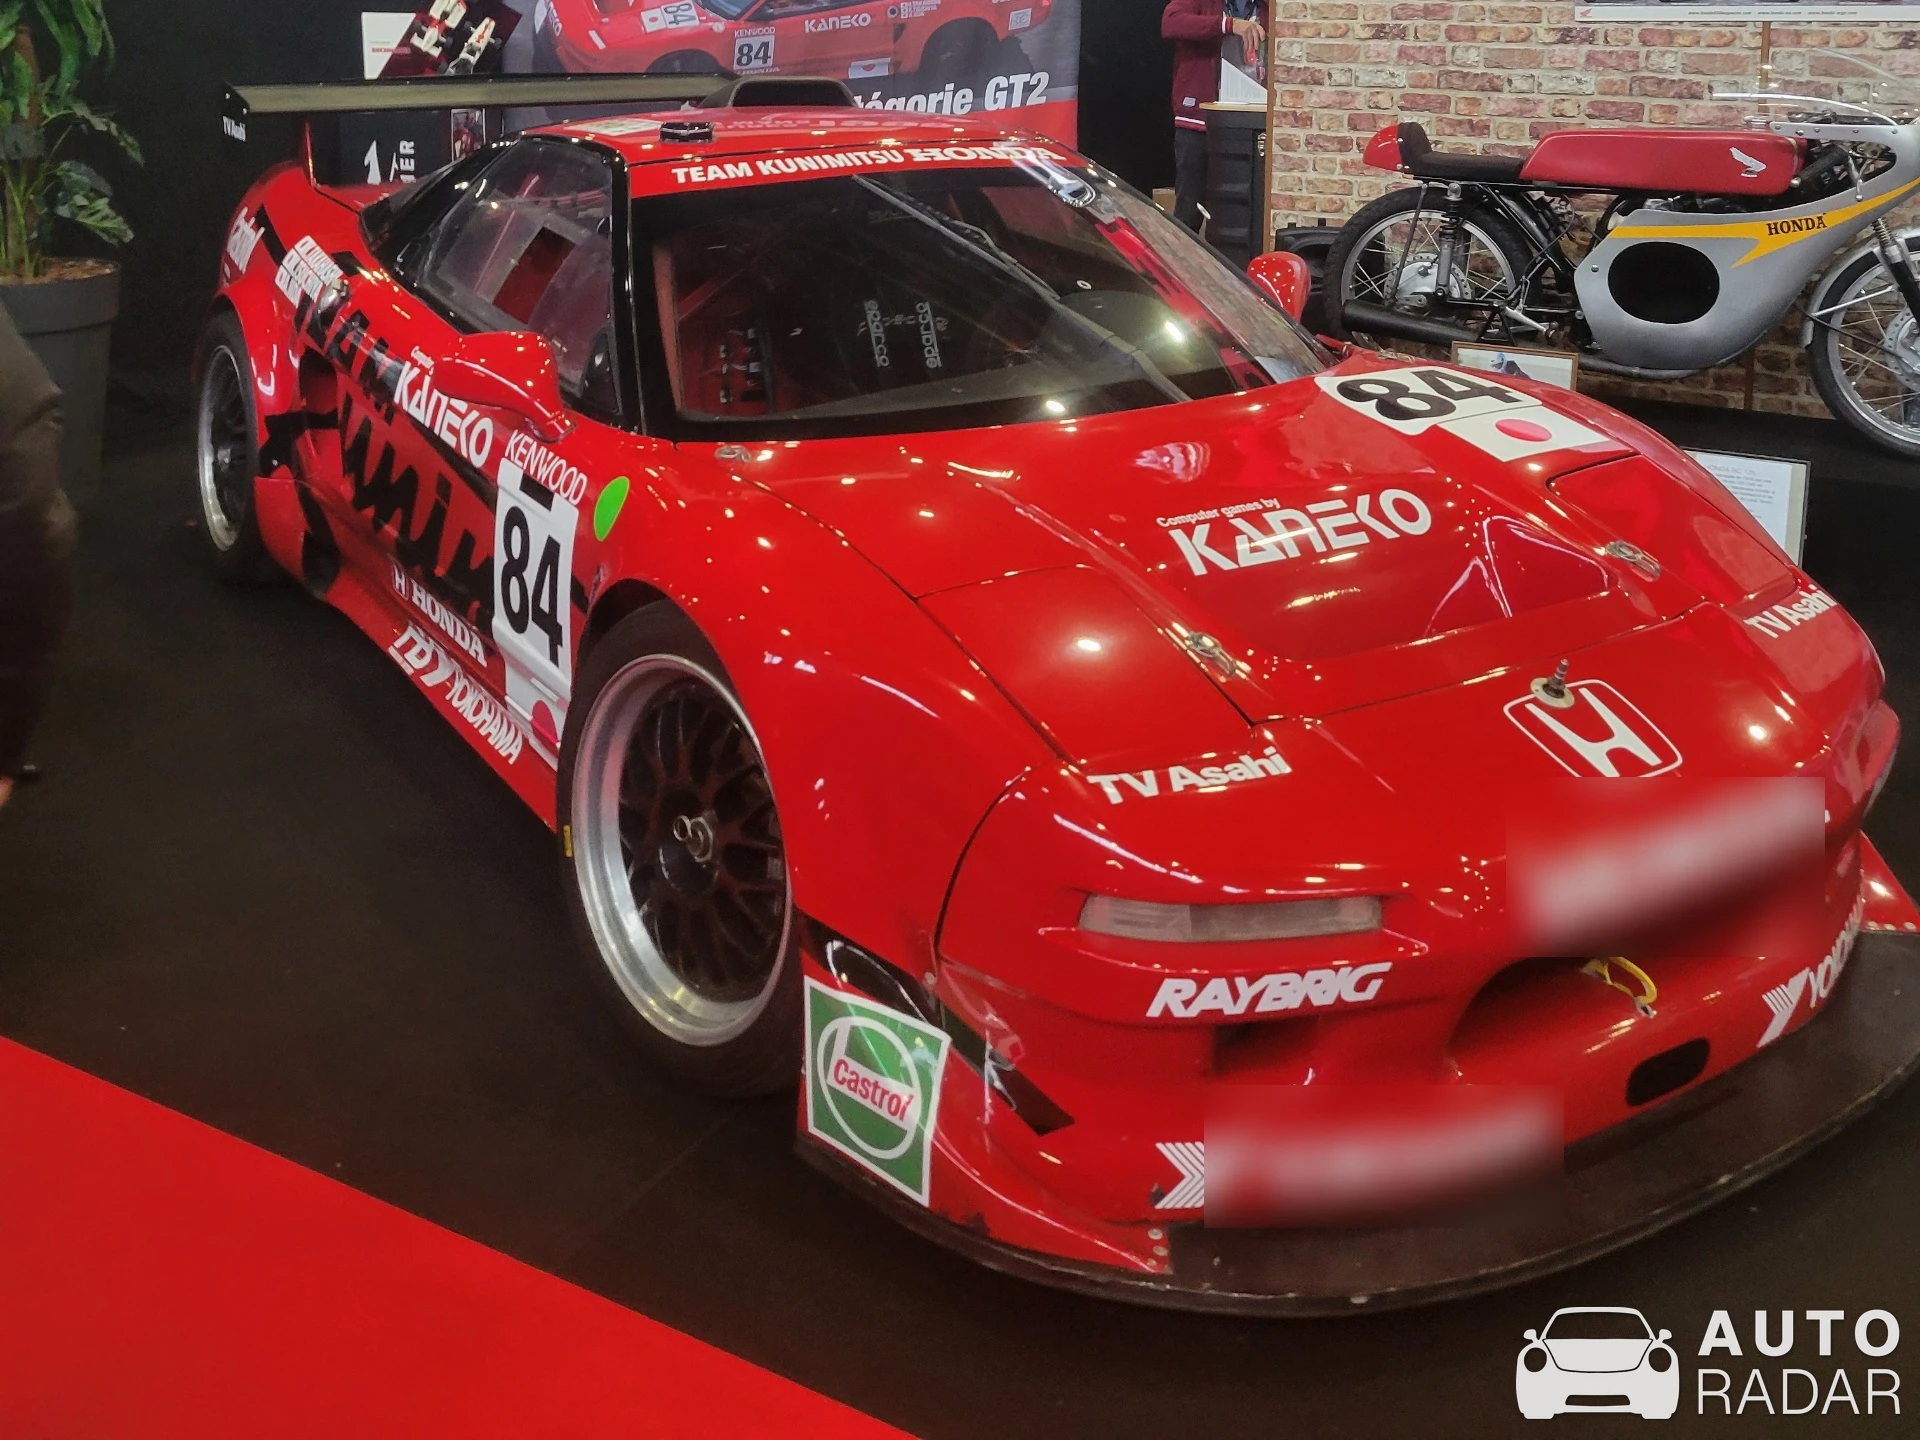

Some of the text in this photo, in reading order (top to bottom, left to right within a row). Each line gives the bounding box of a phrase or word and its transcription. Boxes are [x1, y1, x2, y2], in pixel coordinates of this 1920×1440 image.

[734, 26, 776, 38] KENWOOD
[804, 12, 871, 34] KANEKO
[736, 40, 771, 67] 84
[984, 71, 1049, 111] GT2
[672, 146, 1067, 184] TEAM KUNIMITSU HONDA
[1766, 212, 1828, 236] HONDA
[915, 300, 942, 369] sparco
[394, 361, 494, 468] KANEKO
[1336, 369, 1526, 421] 84
[505, 428, 588, 506] KENWOOD
[1156, 498, 1281, 528] Computer games by
[1168, 489, 1432, 576] KANEKO
[500, 505, 563, 668] 84
[1743, 583, 1838, 639] TV Asahi
[411, 579, 488, 668] HONDA
[445, 665, 524, 765] YOKOHAMA
[1087, 746, 1293, 805] TV Asahi
[1145, 962, 1394, 1018] RAYBRIG
[833, 1058, 915, 1122] Castrol
